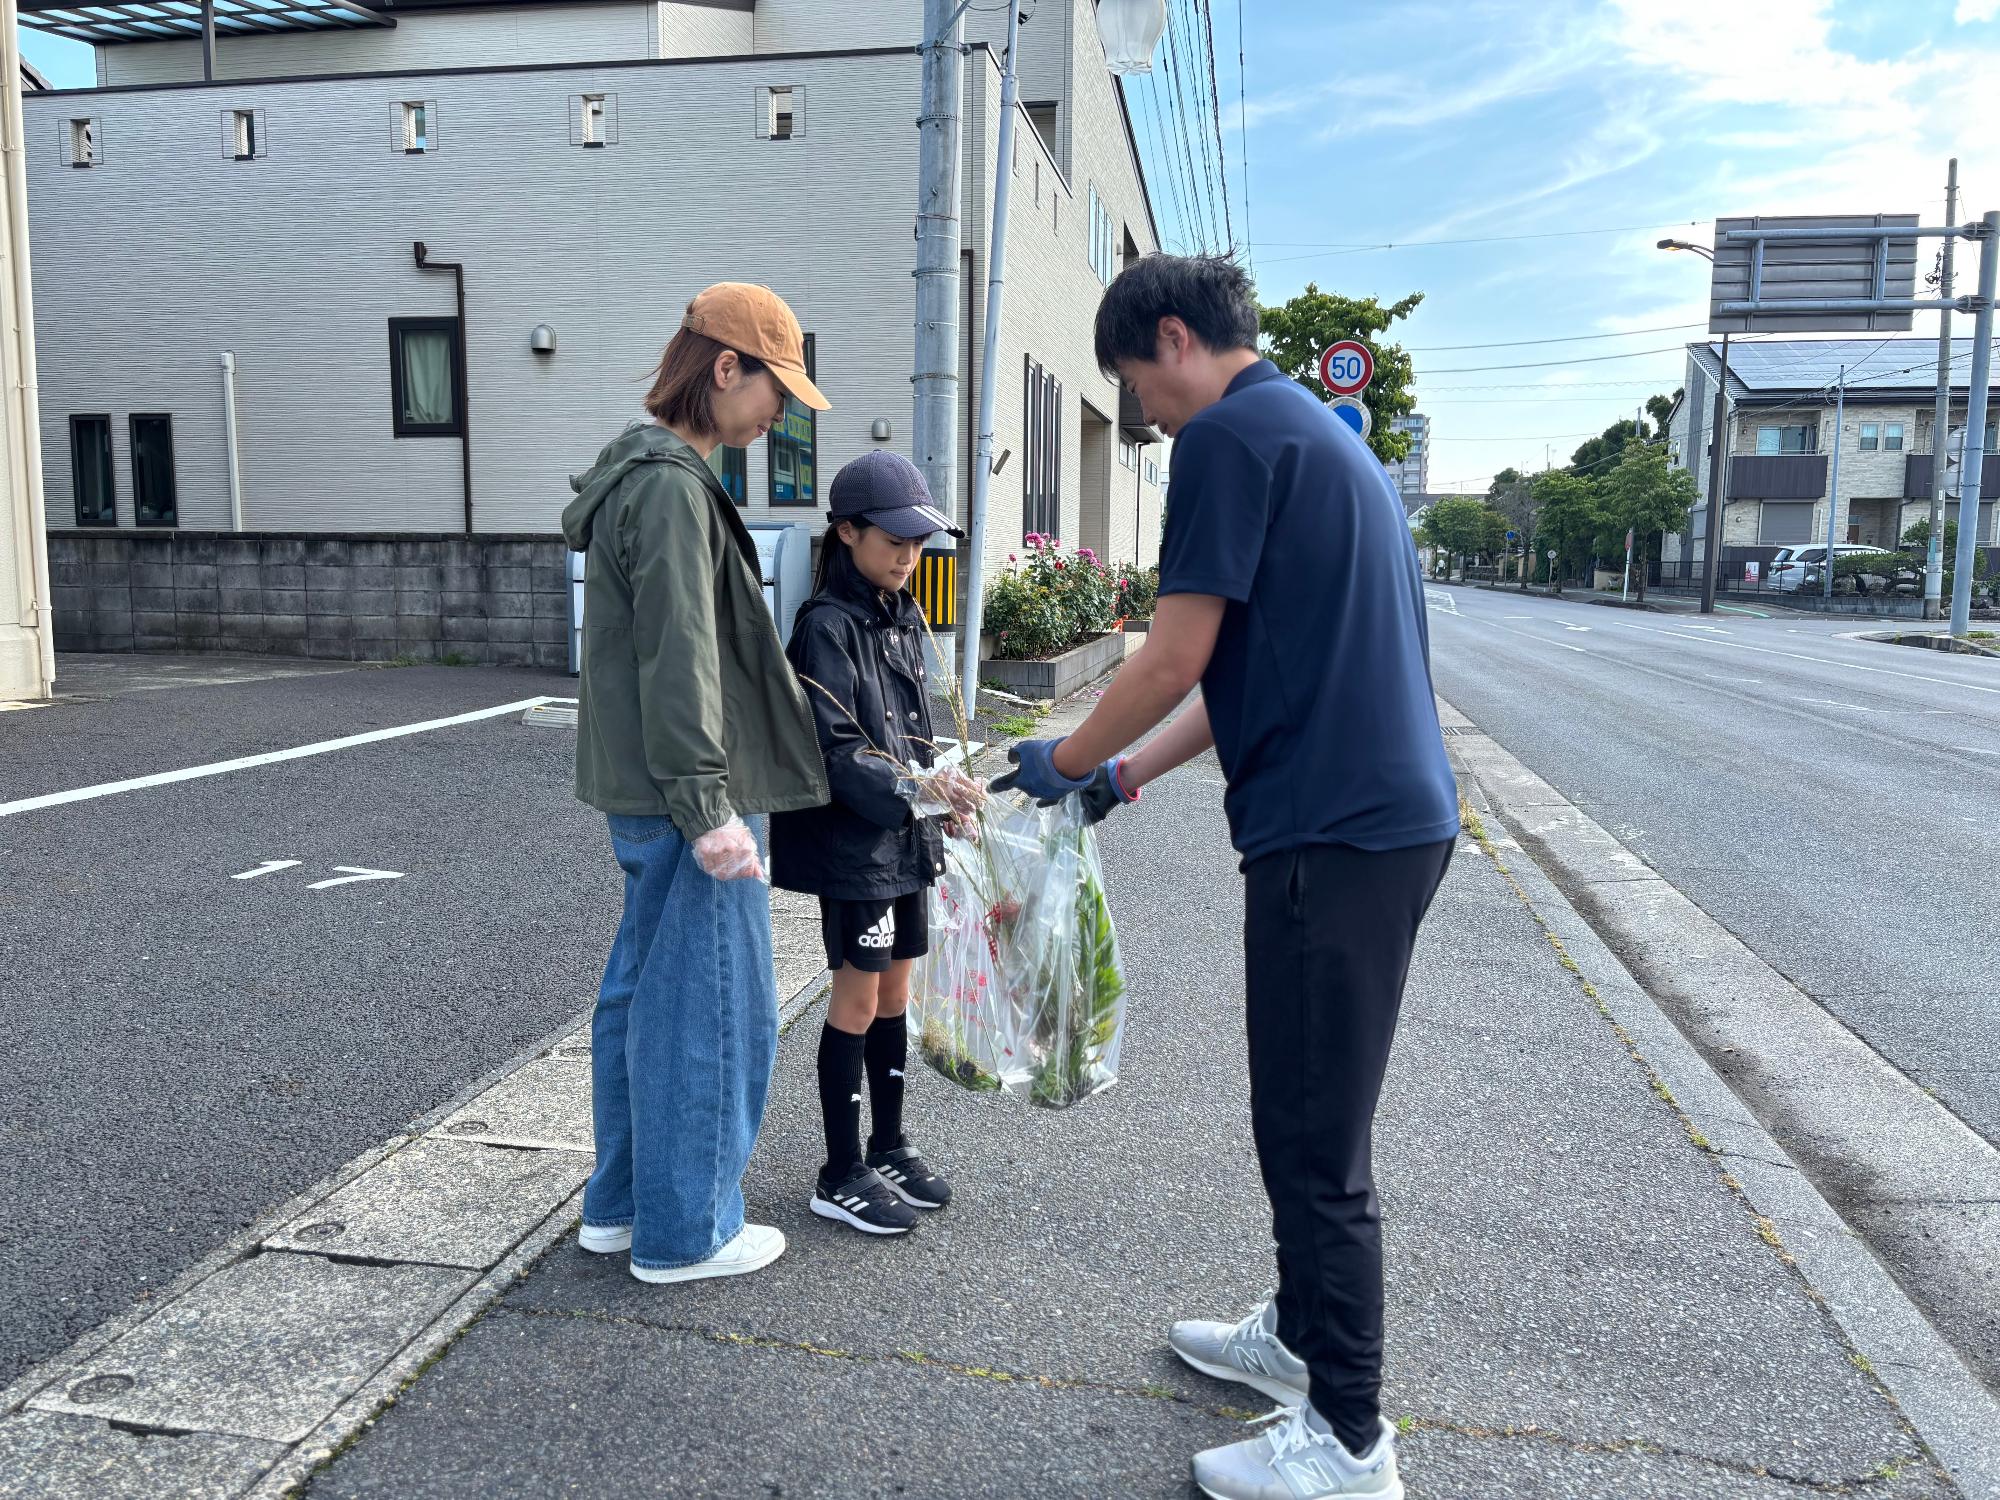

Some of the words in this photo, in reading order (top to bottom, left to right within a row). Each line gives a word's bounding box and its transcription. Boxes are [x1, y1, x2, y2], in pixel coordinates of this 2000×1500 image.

[1332, 356, 1361, 380] 50
[230, 859, 406, 890] 17
[1234, 1346, 1271, 1377] N
[1285, 1457, 1335, 1495] N
